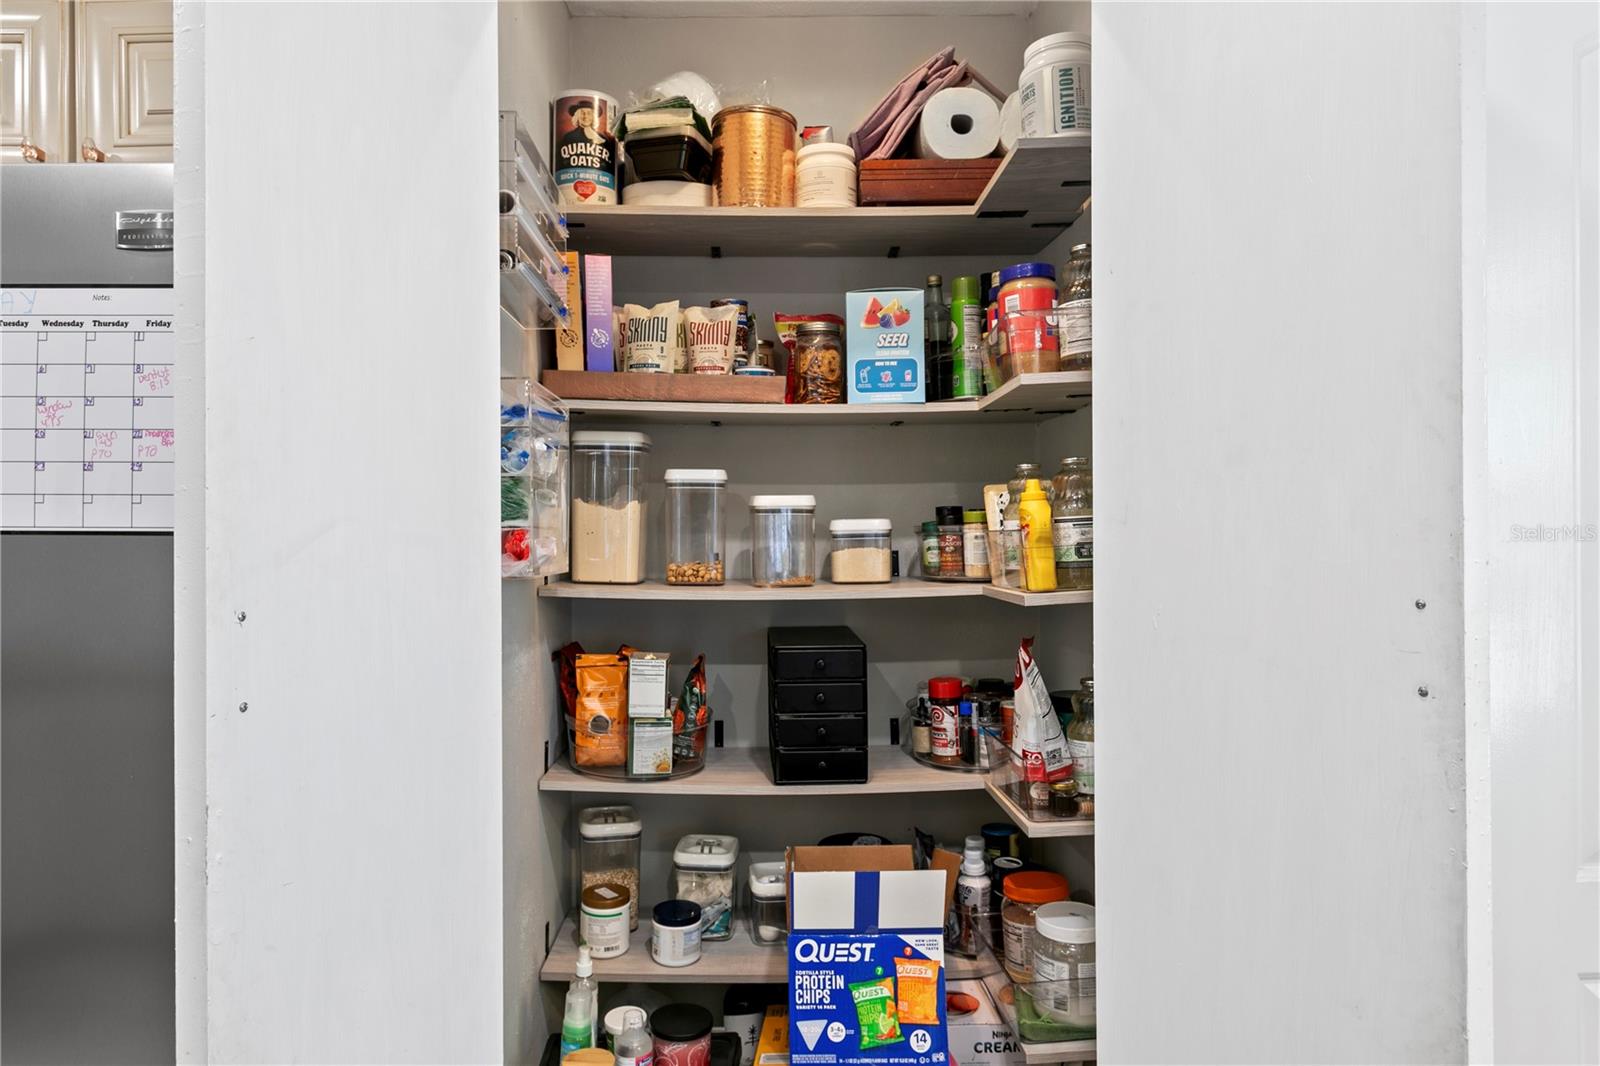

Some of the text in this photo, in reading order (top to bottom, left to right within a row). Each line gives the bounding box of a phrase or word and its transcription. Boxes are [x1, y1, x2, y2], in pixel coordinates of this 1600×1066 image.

[1059, 67, 1076, 129] IGNITION
[560, 142, 610, 161] QUAKER
[570, 156, 600, 168] OATS
[42, 319, 85, 328] Wednesday
[92, 319, 130, 328] Thursday
[146, 319, 172, 328] Friday
[628, 316, 668, 344] SKINNY
[690, 320, 732, 347] SKINNY
[876, 333, 909, 348] SEEQ
[795, 938, 876, 963] QUEST
[897, 966, 928, 976] QUEST
[795, 975, 845, 990] PROTEIN
[795, 989, 831, 1004] CHIPS
[853, 988, 885, 1000] QUEST
[914, 1033, 928, 1044] 14
